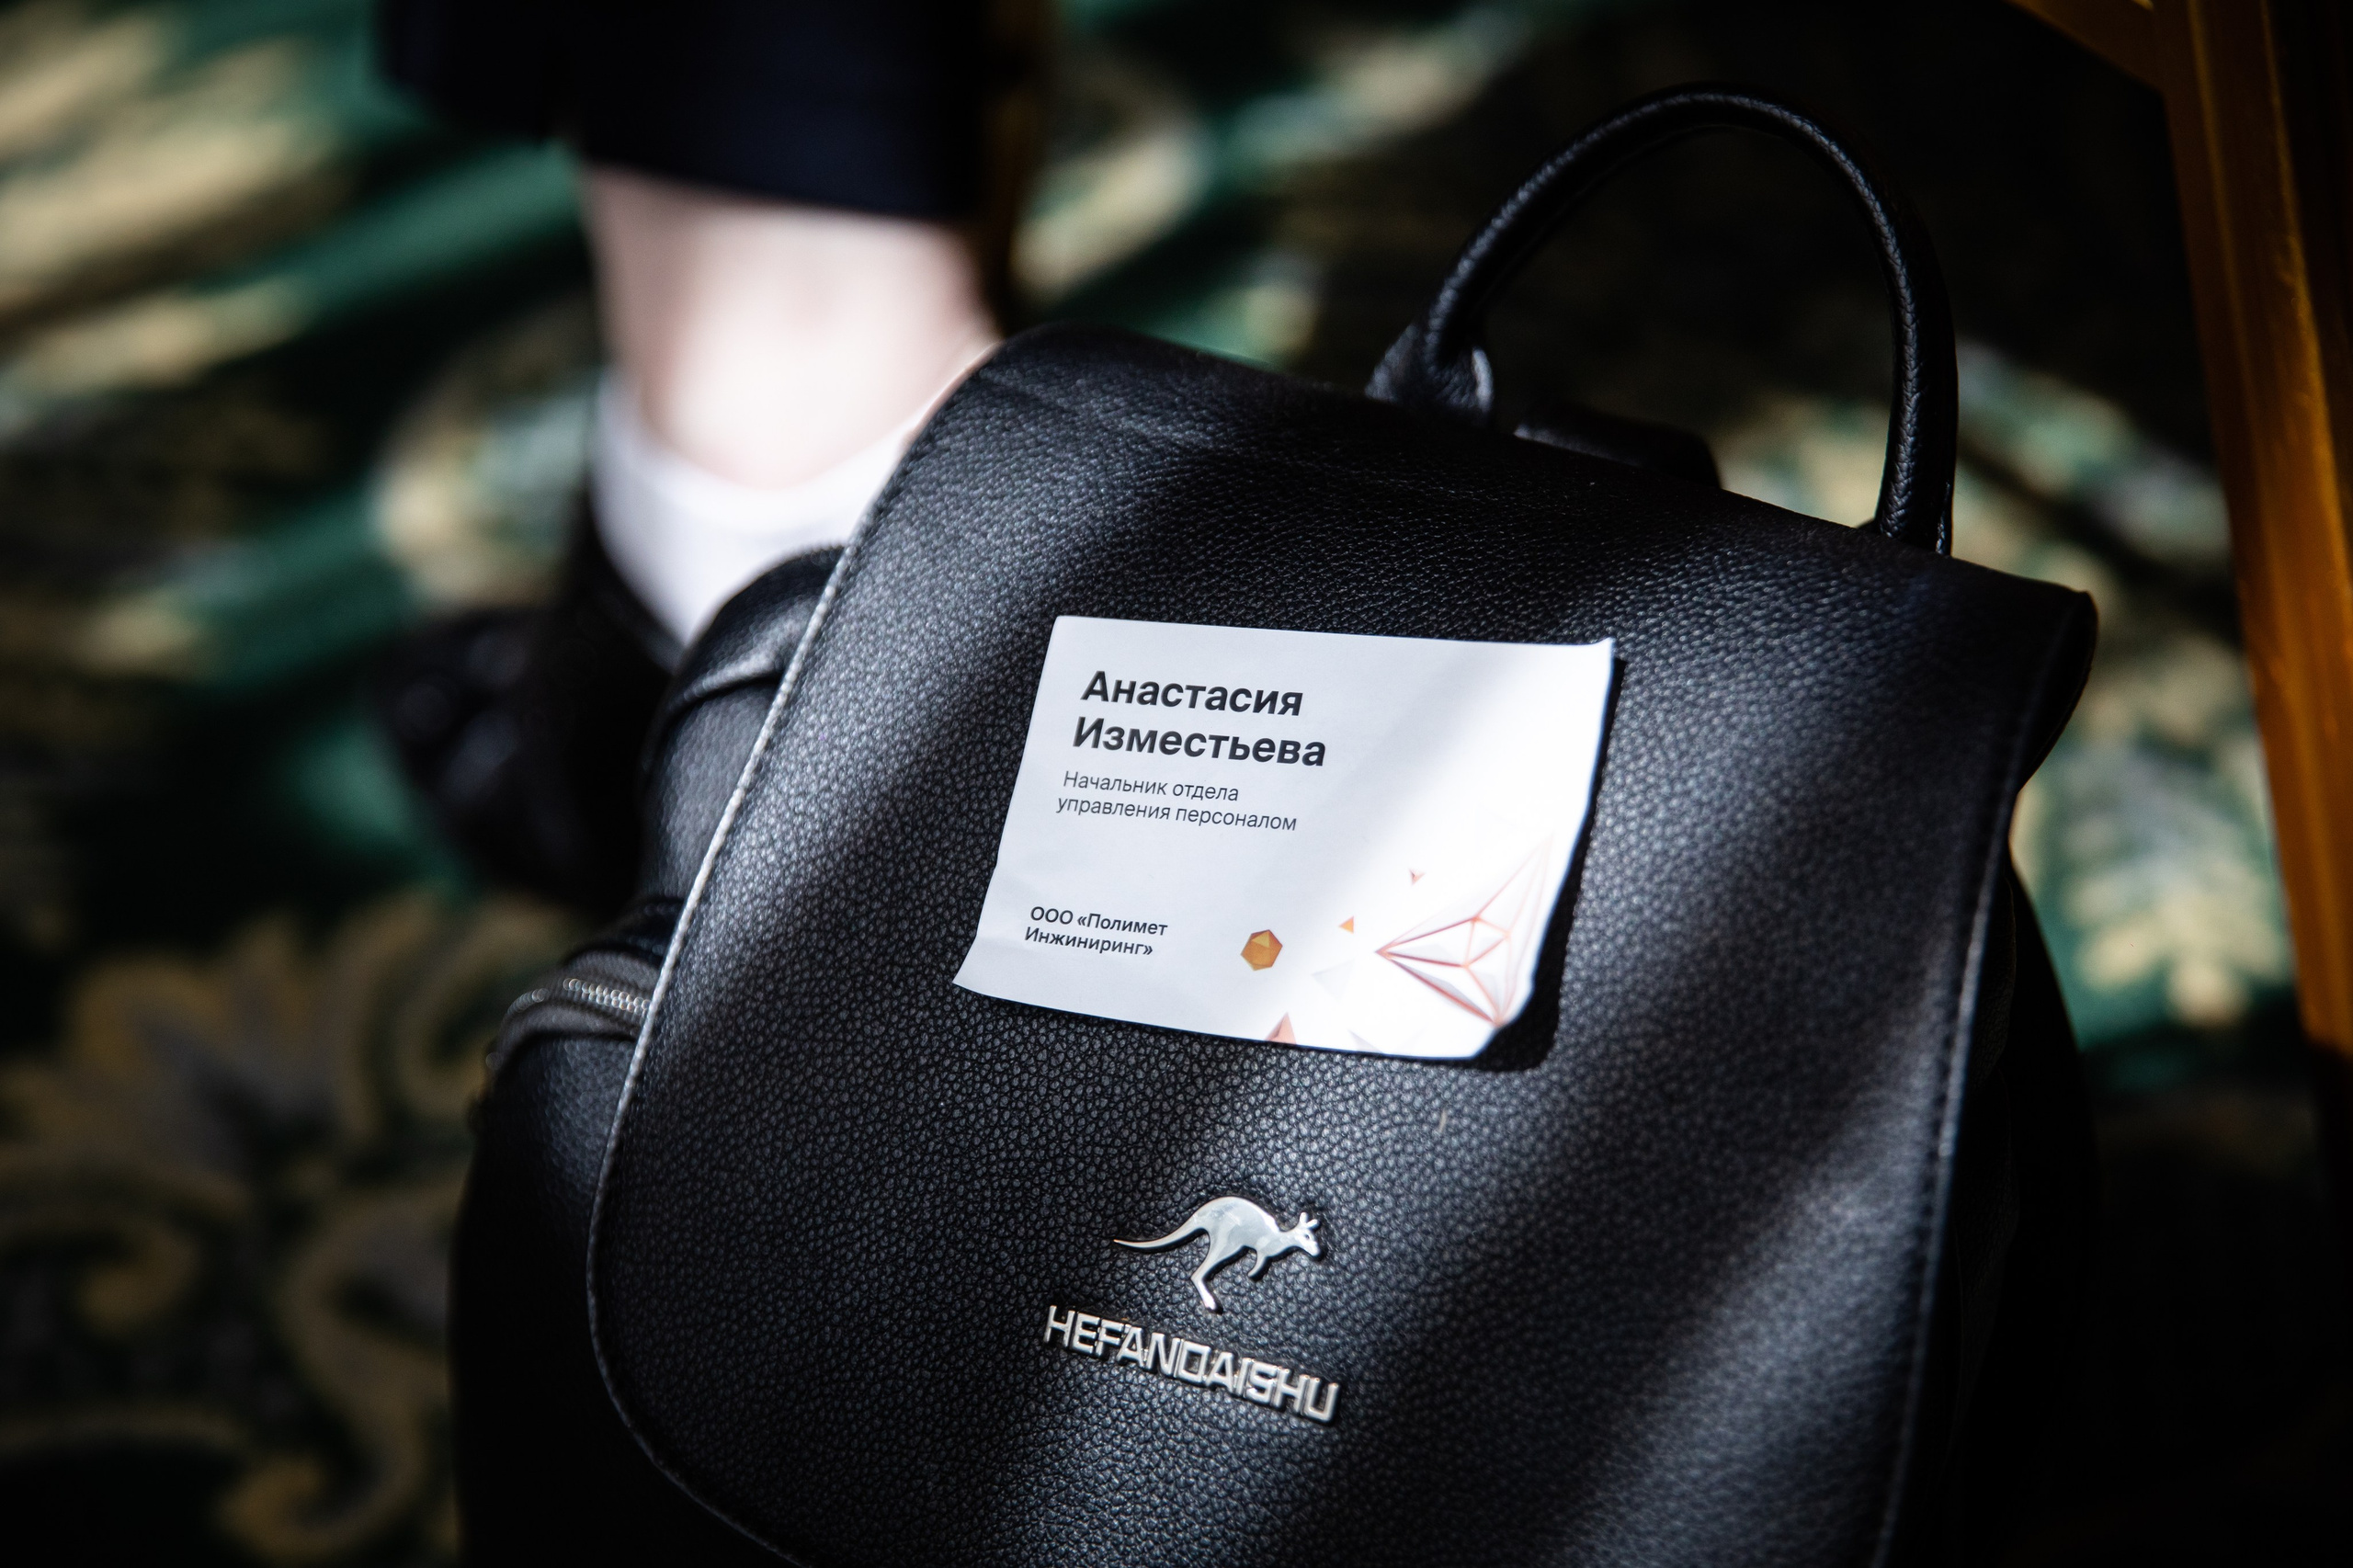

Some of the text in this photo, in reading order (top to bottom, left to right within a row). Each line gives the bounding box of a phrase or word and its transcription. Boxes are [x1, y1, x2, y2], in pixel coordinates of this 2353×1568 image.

[1080, 670, 1304, 716] Анастасия
[1072, 716, 1327, 767] Изместьева
[1063, 770, 1239, 802] Начальник отдела
[1056, 796, 1297, 831] управления персоналом
[1029, 905, 1168, 936] ООО «Полимет
[1025, 926, 1154, 956] Инжиниринг»
